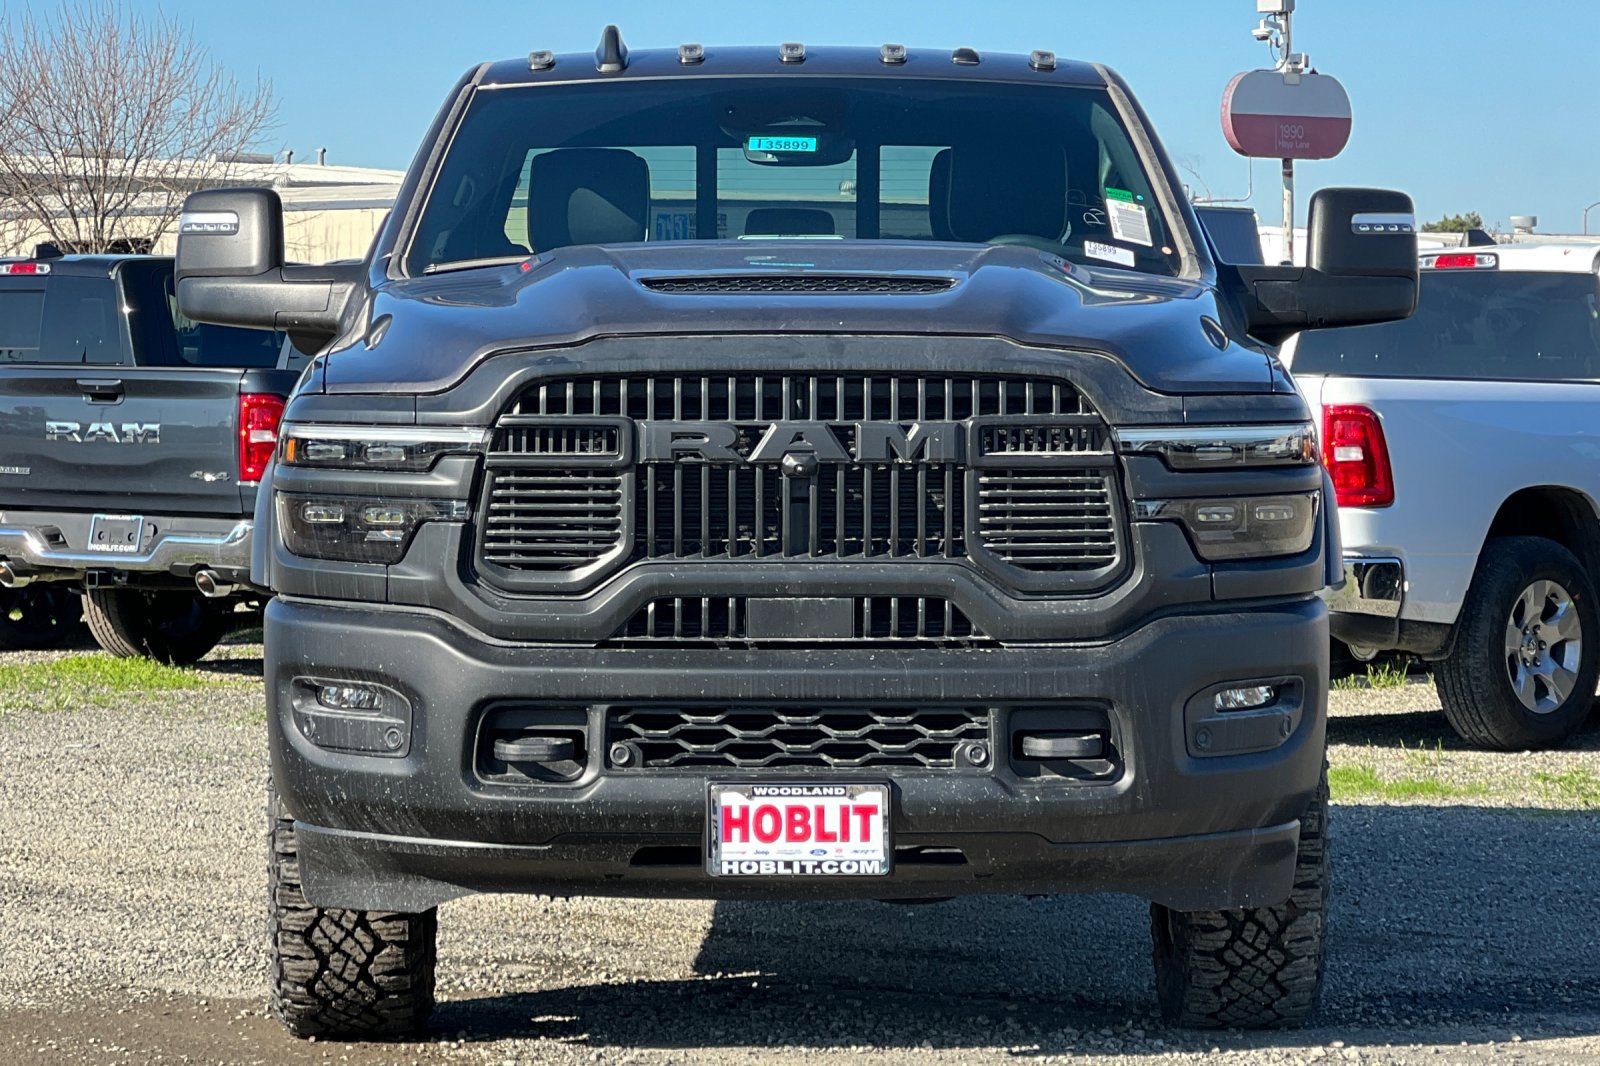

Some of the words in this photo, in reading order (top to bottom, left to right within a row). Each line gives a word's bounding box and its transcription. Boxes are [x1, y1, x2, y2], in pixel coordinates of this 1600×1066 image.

[1280, 125, 1304, 139] 1990
[46, 421, 160, 443] RAM
[641, 422, 960, 463] RAM
[753, 787, 846, 796] WOODLAND
[721, 804, 878, 844] HOBLIT
[721, 860, 881, 874] HOBLIT.COM
